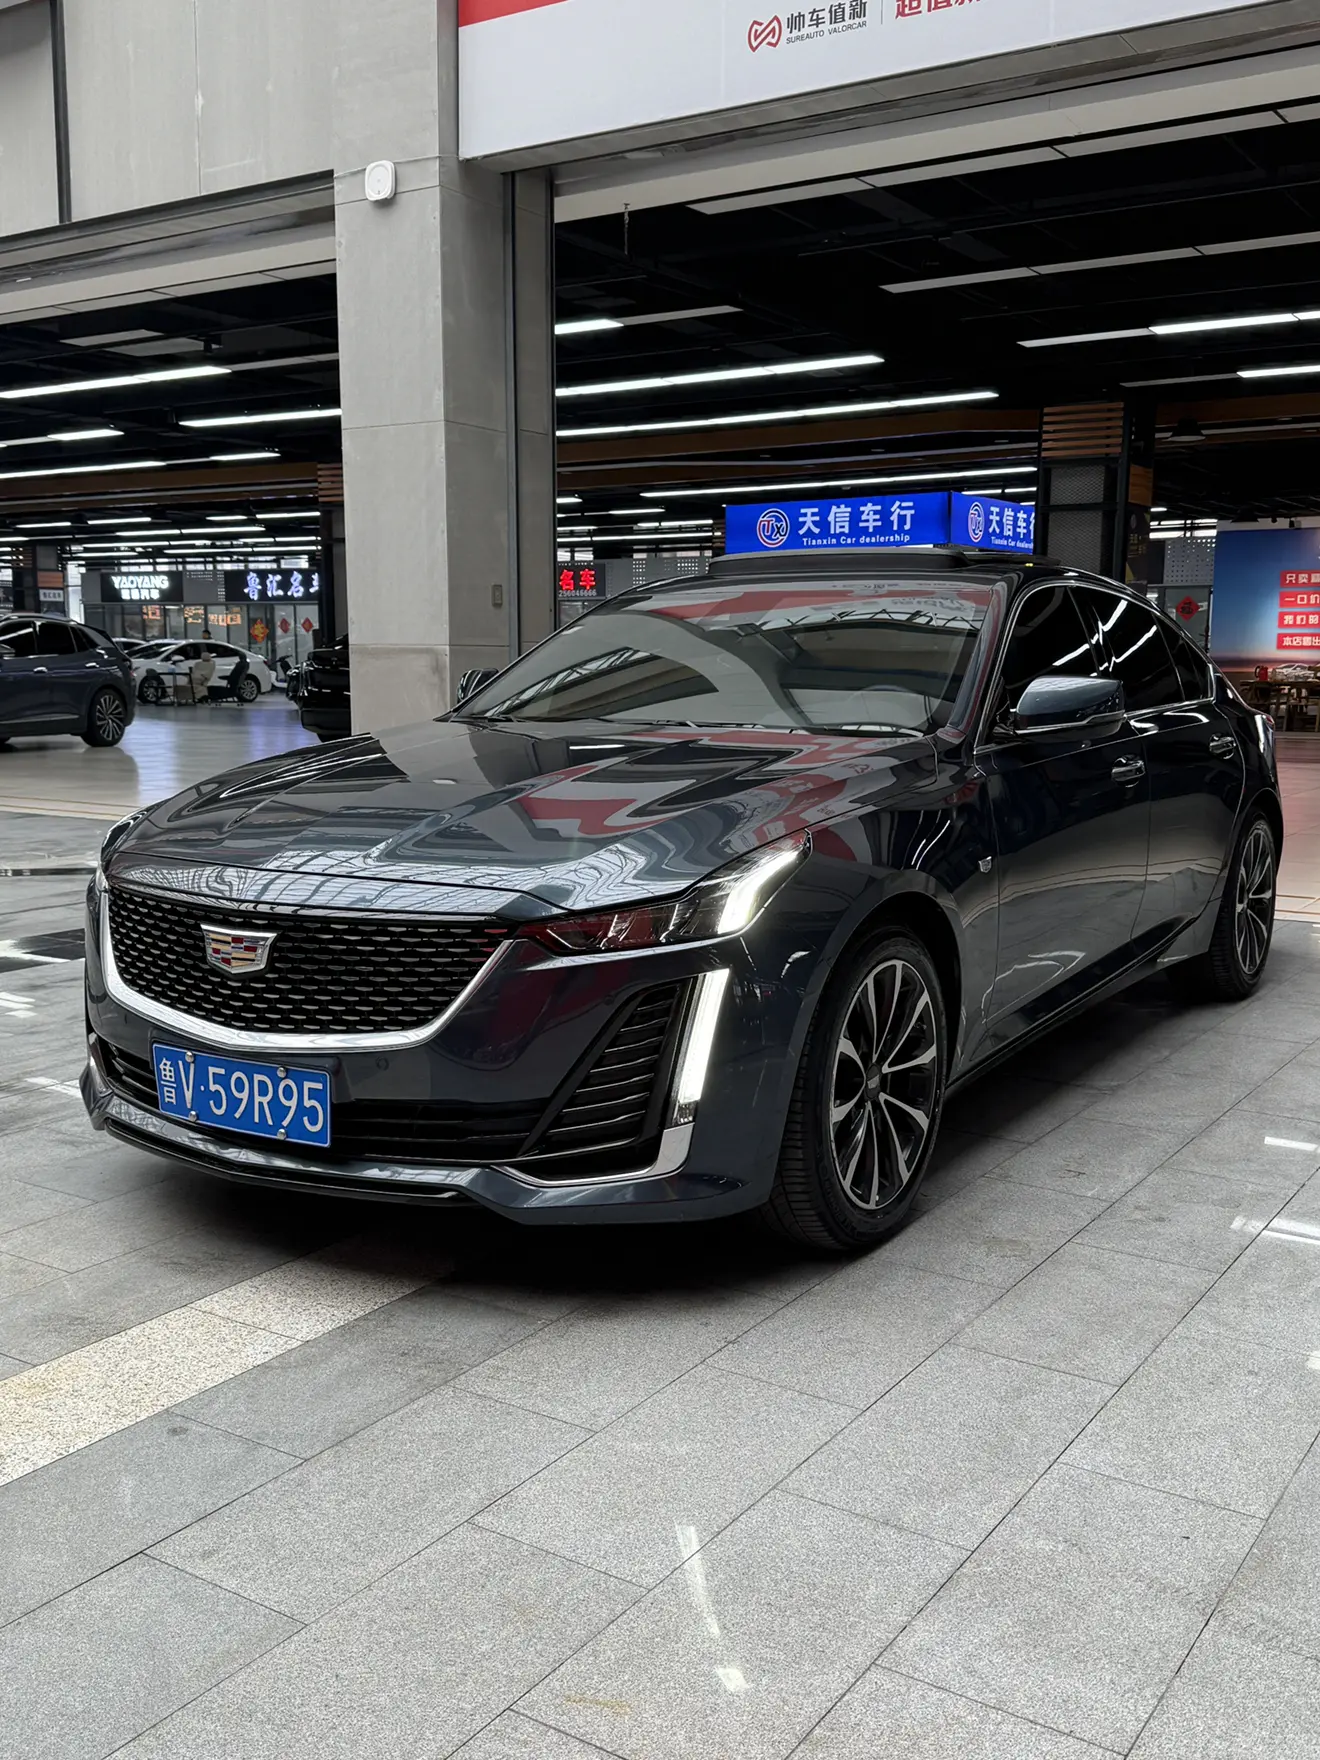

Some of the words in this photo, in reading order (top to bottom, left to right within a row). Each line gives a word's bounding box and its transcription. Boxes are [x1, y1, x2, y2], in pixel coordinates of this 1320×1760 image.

[786, 0, 867, 34] 帅车值新
[786, 29, 825, 45] SUREAUTO
[827, 20, 867, 35] VALORCAR
[798, 500, 915, 535] 天信车行
[802, 536, 837, 546] Tianxin
[840, 536, 856, 544] Car
[859, 533, 911, 544] dealership
[111, 575, 169, 589] YAOYANG
[559, 568, 596, 591] 名车
